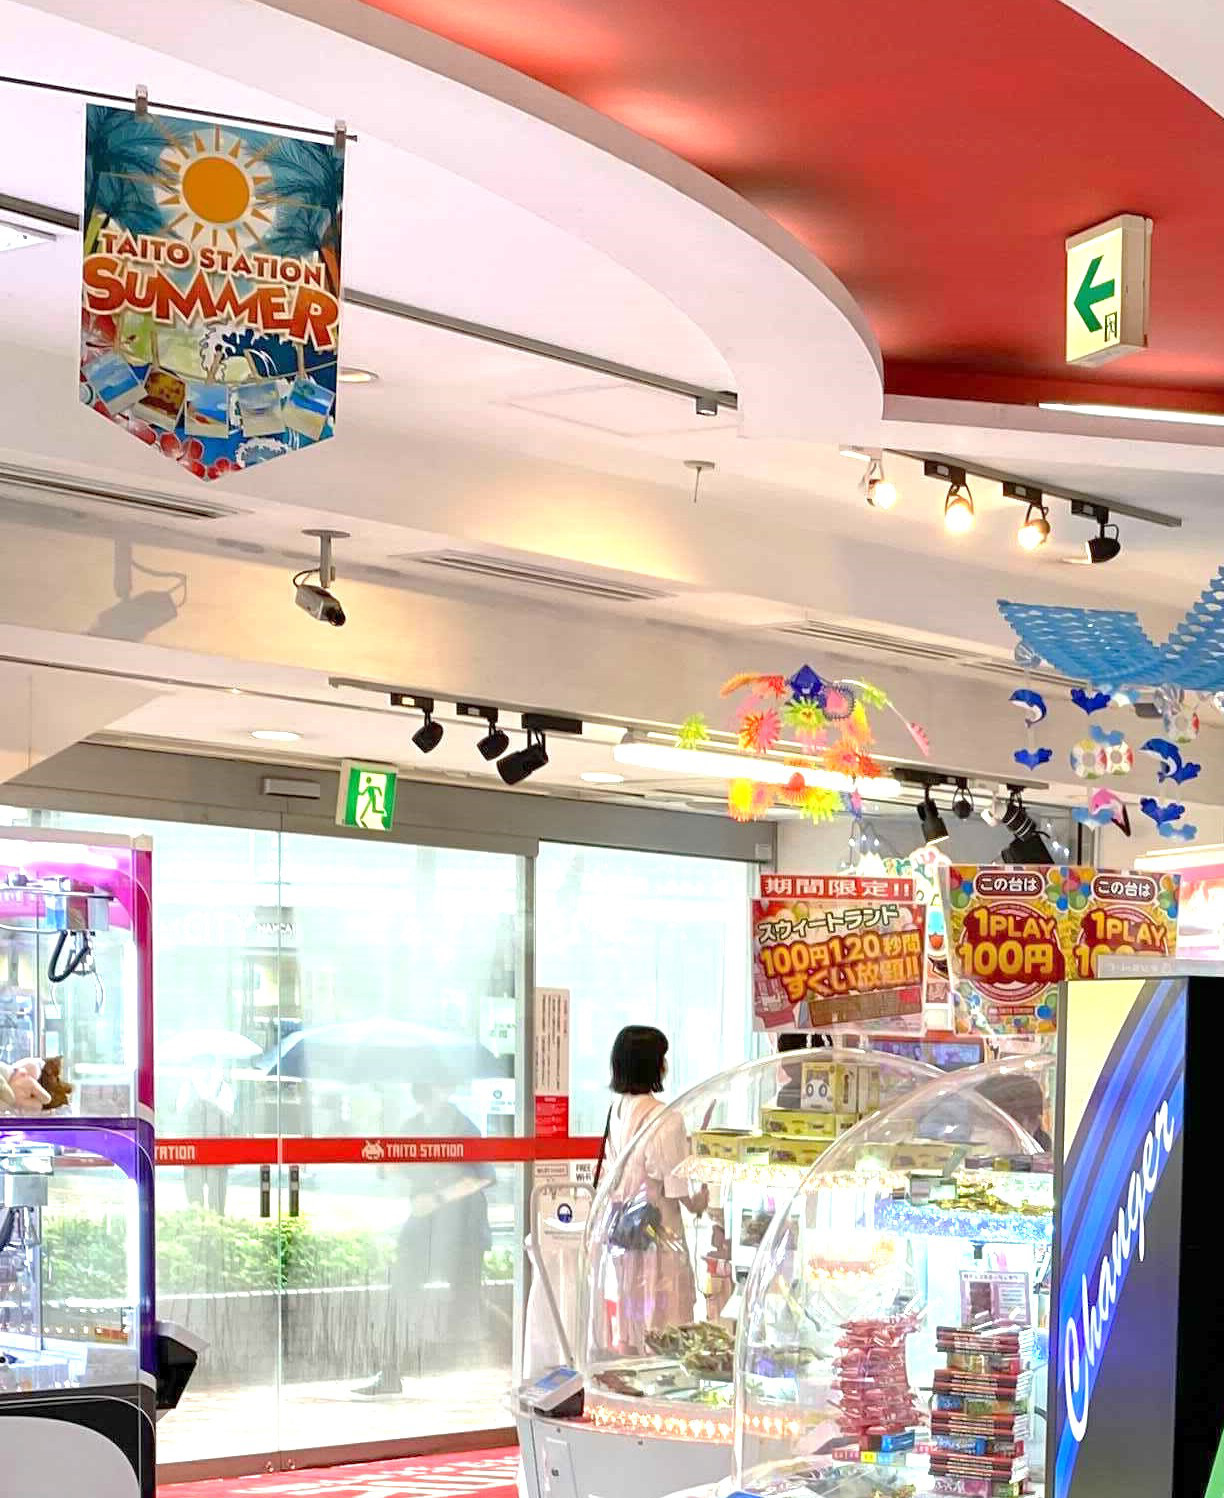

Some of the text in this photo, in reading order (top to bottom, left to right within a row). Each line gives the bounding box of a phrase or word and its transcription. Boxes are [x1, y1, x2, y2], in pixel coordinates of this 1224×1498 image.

[101, 231, 324, 286] TAITO STATION
[83, 256, 339, 349] SUMMER
[763, 877, 913, 899] 期間限定!!
[980, 872, 1038, 894] この台は
[1097, 879, 1153, 899] この台は
[758, 905, 900, 943] スウィートランド
[973, 906, 1057, 941] 1PLAY
[1094, 911, 1167, 948] 1PLAY
[959, 940, 1054, 978] 100円
[387, 1142, 464, 1157] TAITO STATION
[1065, 1100, 1175, 1442] Changer
